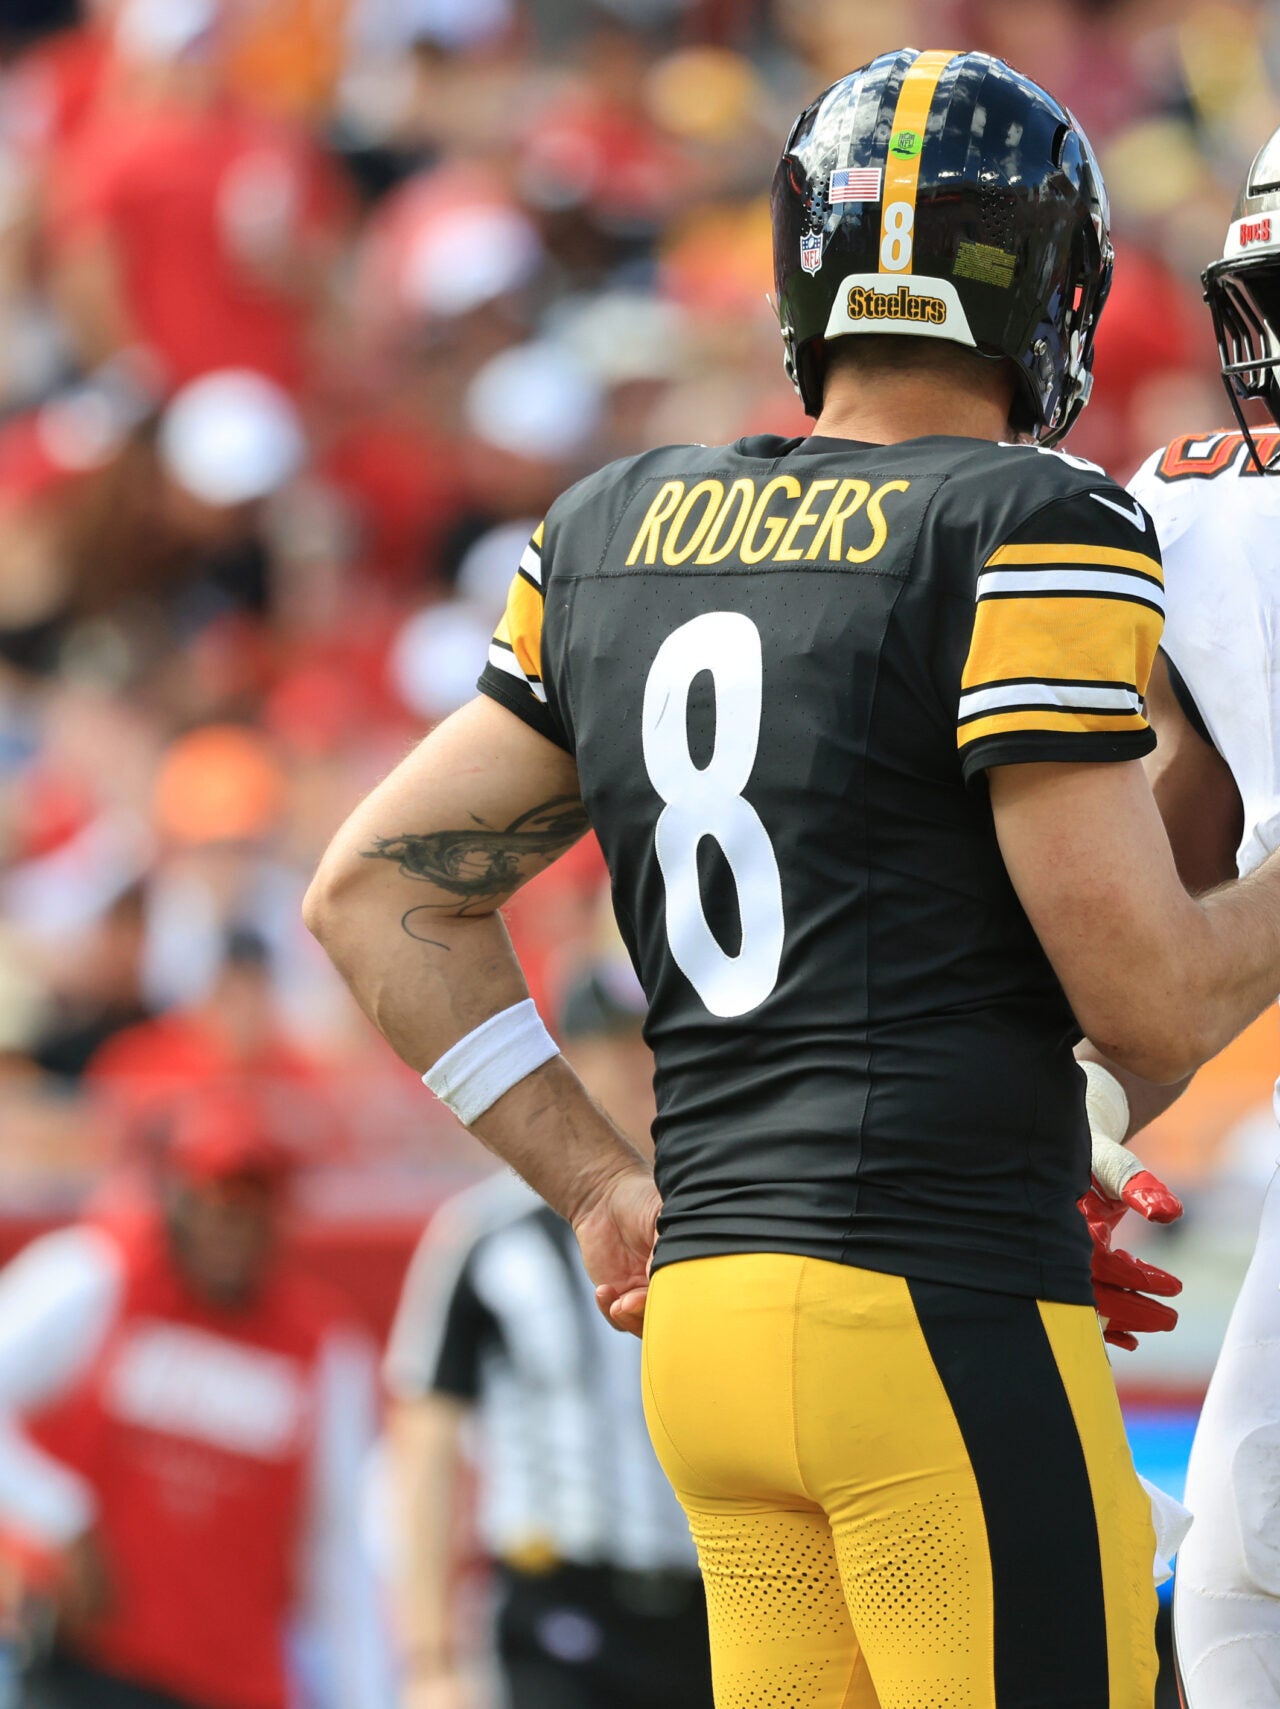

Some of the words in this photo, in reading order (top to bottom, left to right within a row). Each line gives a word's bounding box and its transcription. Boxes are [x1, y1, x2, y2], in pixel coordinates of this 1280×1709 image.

[803, 249, 820, 268] NFL
[880, 201, 914, 271] 8
[847, 286, 946, 325] Steelers
[624, 475, 910, 566] RODGERS
[641, 611, 785, 1018] 8
